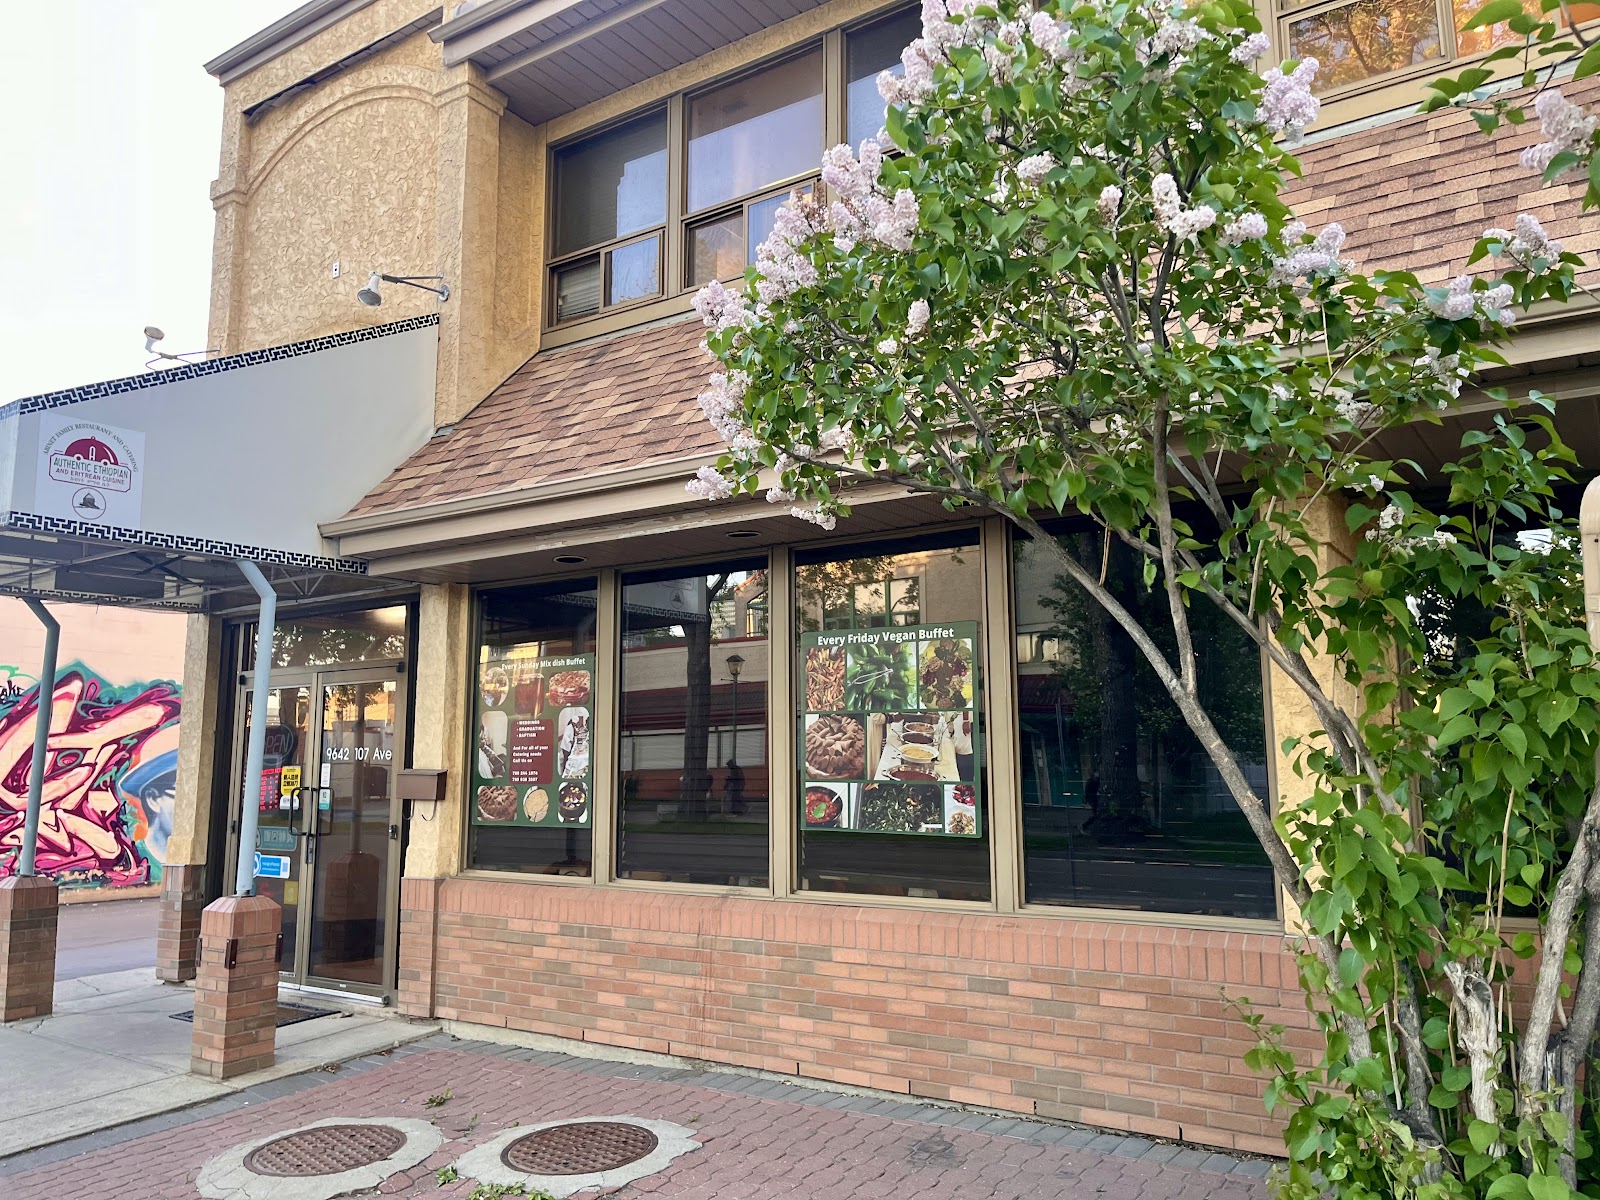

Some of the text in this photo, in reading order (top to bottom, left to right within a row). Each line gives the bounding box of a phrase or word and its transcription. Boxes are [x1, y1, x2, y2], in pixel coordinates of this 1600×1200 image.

[55, 424, 74, 438] FAMILY
[75, 423, 112, 435] RESTAURANT
[112, 434, 124, 446] AND
[122, 444, 139, 473] CATERING
[53, 457, 129, 479] AUTHENTIC ETHIOPIAN
[55, 467, 69, 475] AND
[70, 470, 101, 481] ERITREAN
[102, 476, 126, 485] CUISINE
[817, 627, 954, 647] Every Friday Vegan Buffet
[501, 657, 586, 671] Every Sunday Mix dish Buffet
[326, 746, 392, 761] 9642 107 Ave
